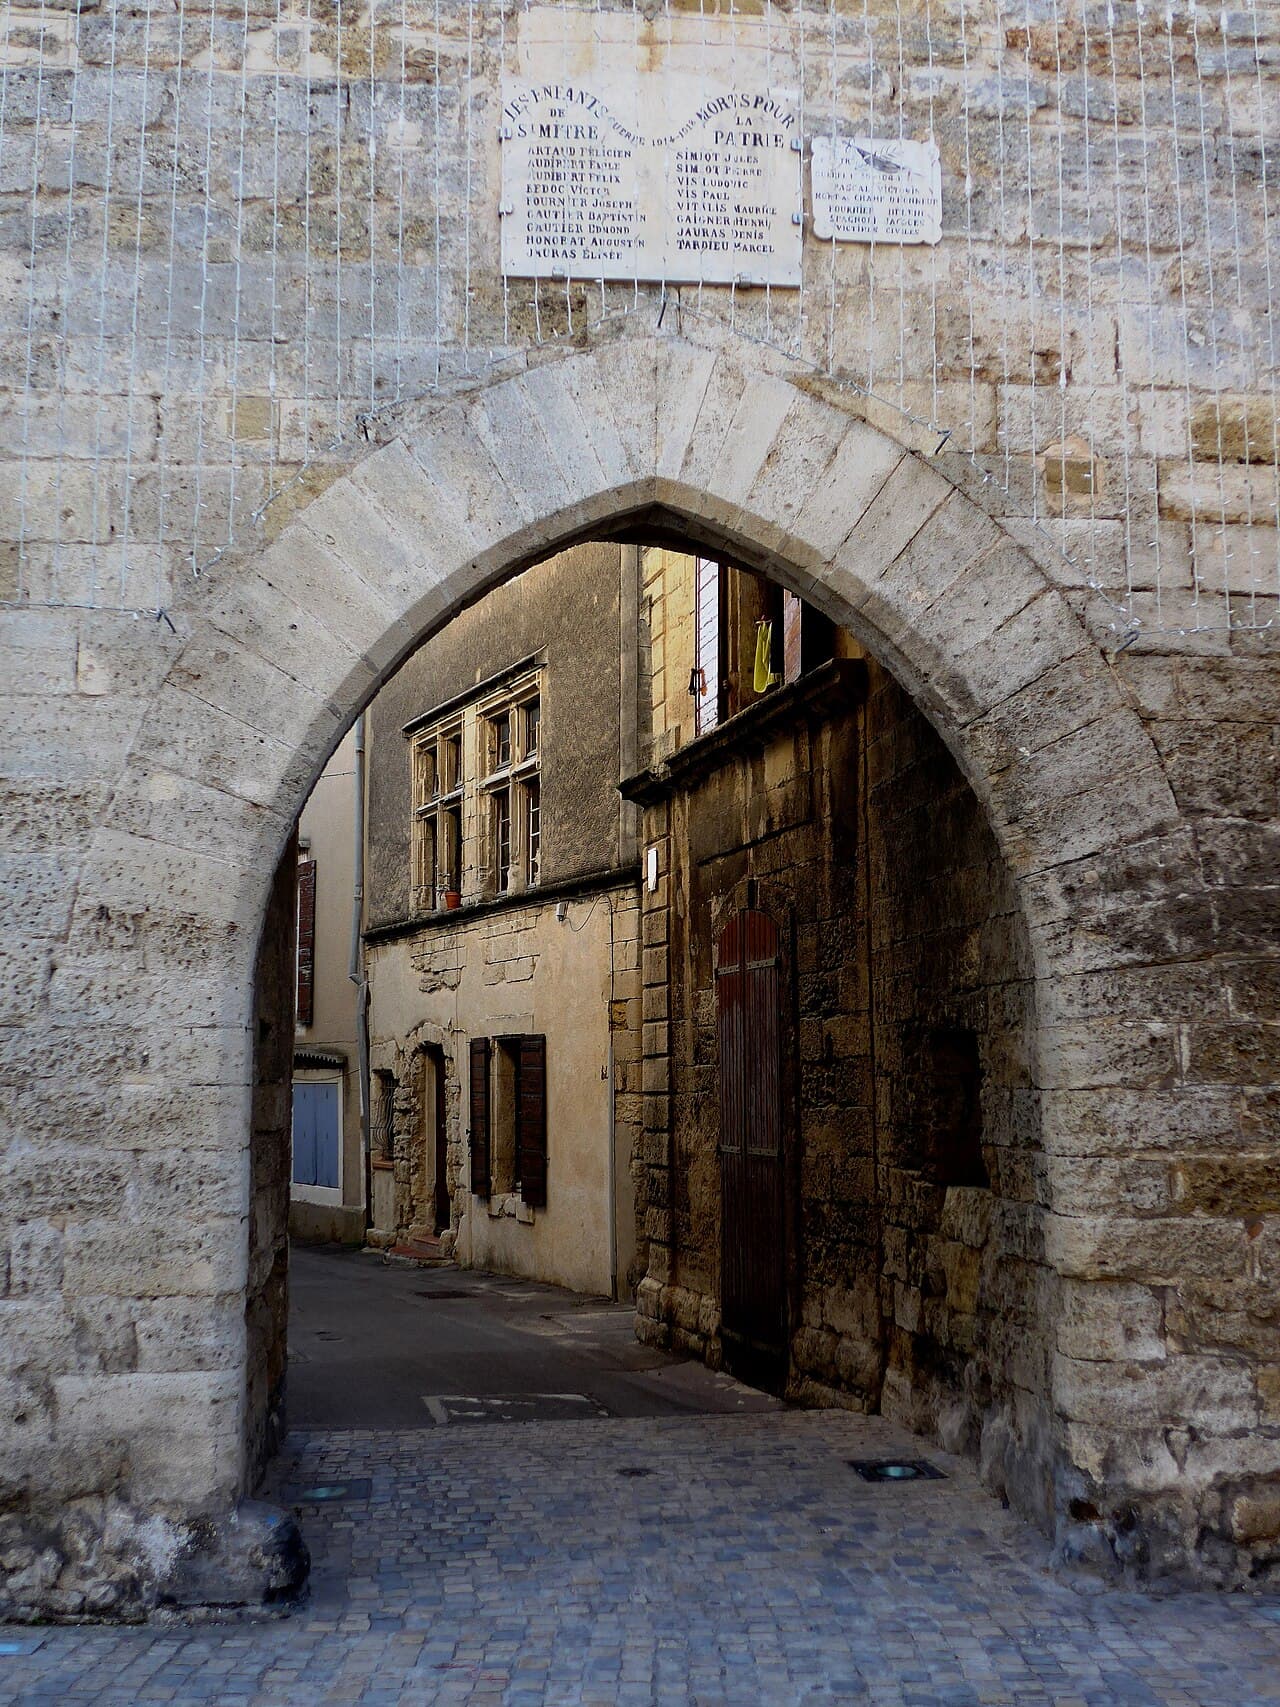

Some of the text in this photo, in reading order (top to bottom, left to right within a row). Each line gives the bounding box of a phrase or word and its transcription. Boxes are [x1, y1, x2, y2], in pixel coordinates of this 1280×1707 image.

[549, 108, 566, 118] DE
[753, 94, 796, 130] POUR
[735, 116, 753, 126] LA
[713, 130, 785, 149] PATRIE
[675, 163, 720, 175] SIMOT
[676, 176, 698, 187] VIS
[676, 188, 730, 201] VIS PAUL
[592, 198, 632, 209] JOSEPH
[526, 222, 585, 234] GAUTIER
[676, 228, 726, 239] JAURAS
[526, 235, 586, 247] HONORAT
[676, 239, 775, 254] TARDIEU MARCEL
[526, 248, 577, 259] JAURAS
